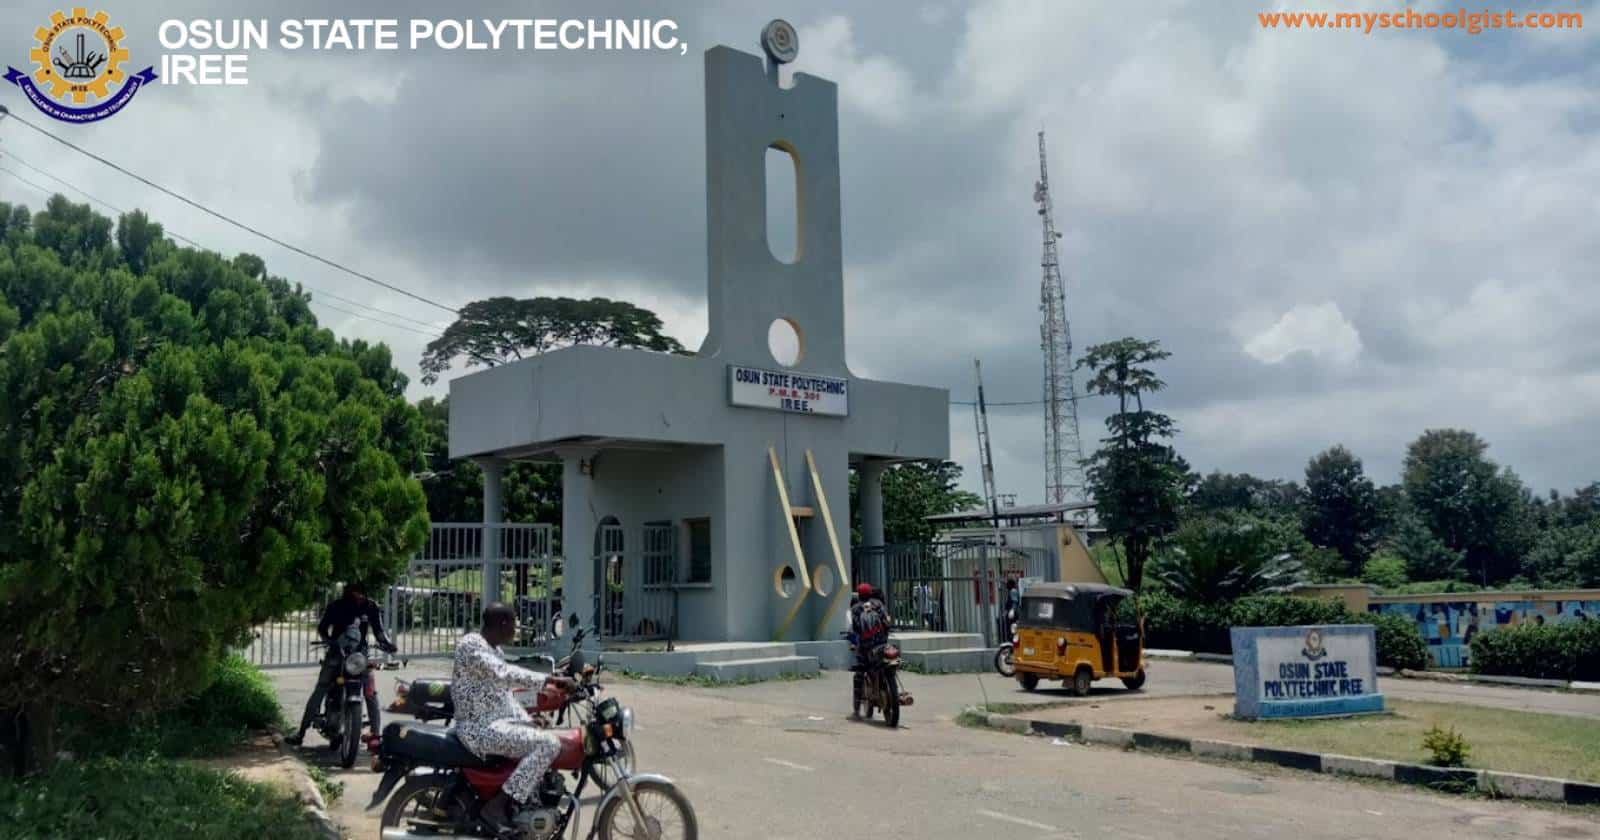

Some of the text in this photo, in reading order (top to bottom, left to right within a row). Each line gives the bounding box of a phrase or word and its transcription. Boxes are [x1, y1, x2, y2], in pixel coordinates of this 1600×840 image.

[736, 369, 845, 395] OSUN STATE POLYTECHNIC
[1279, 661, 1348, 679] OSUN STATE
[1264, 678, 1363, 698] POLYTECHNIC IREE
